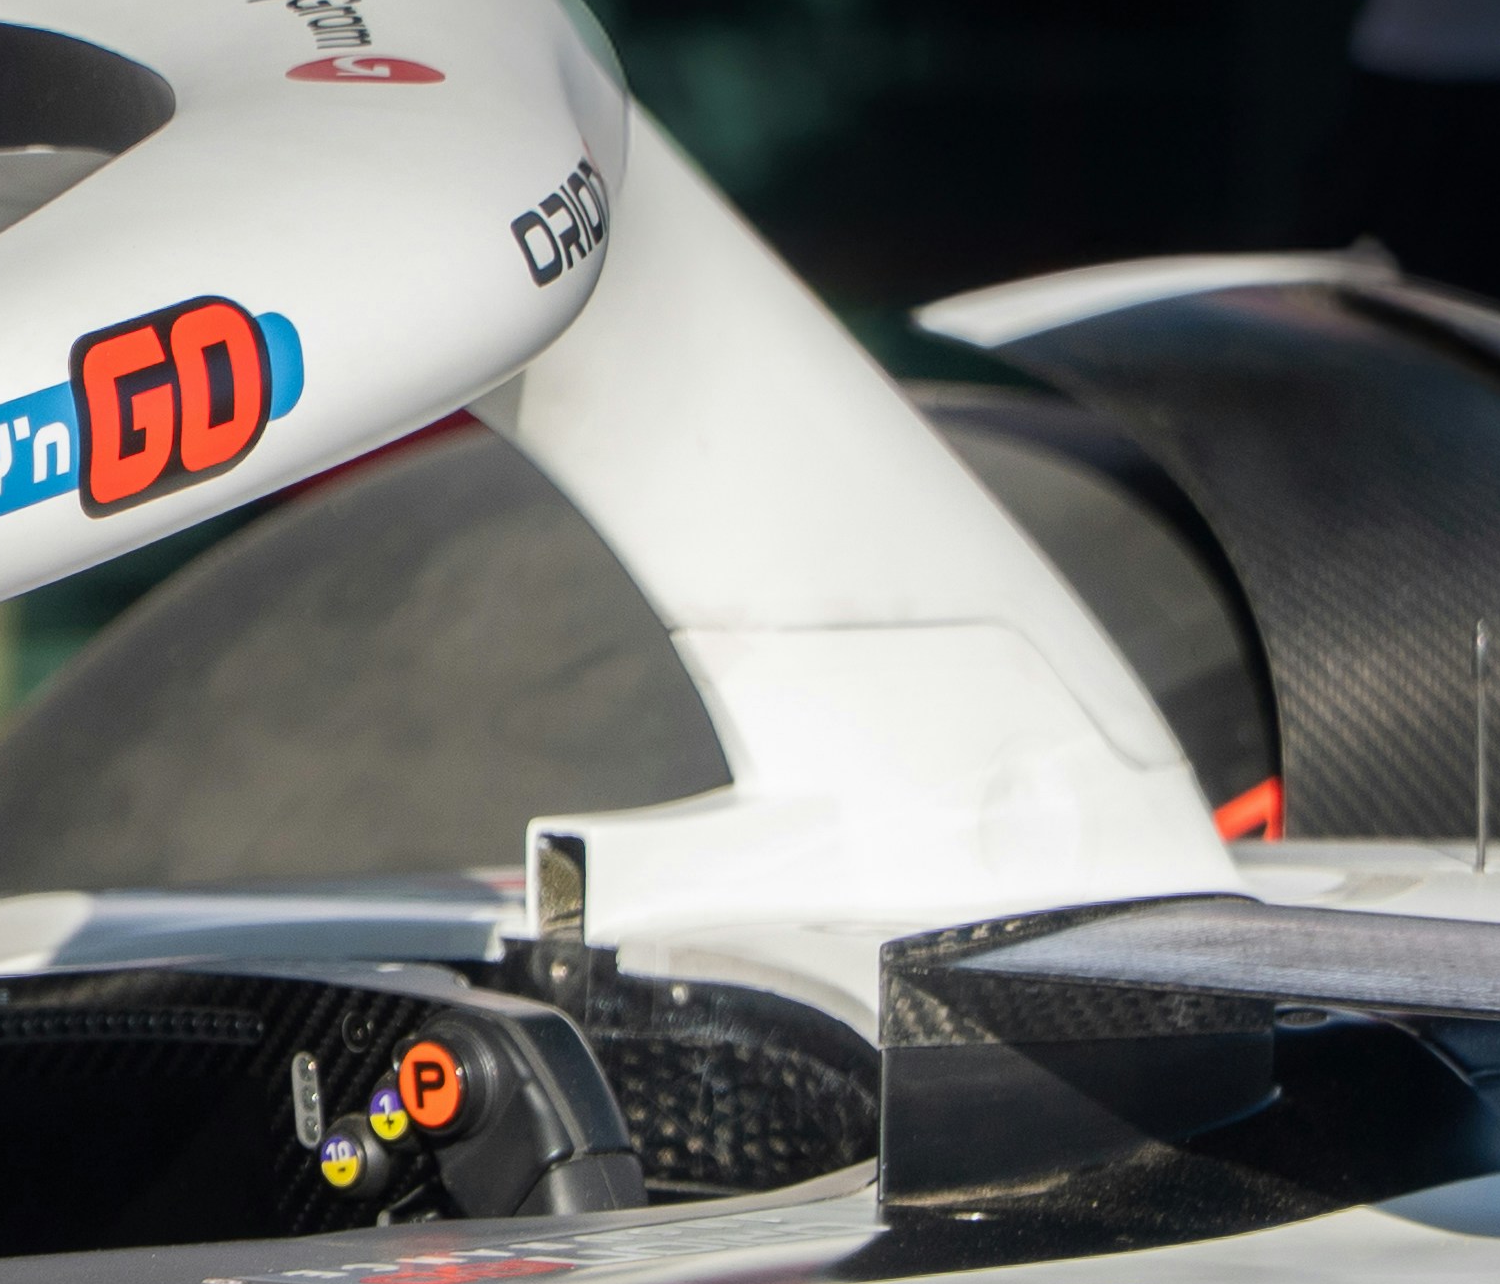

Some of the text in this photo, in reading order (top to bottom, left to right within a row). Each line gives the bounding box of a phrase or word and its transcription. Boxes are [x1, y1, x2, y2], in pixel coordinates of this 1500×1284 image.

[81, 302, 264, 505] GO
[412, 1060, 446, 1110] P
[325, 1139, 353, 1162] 10
